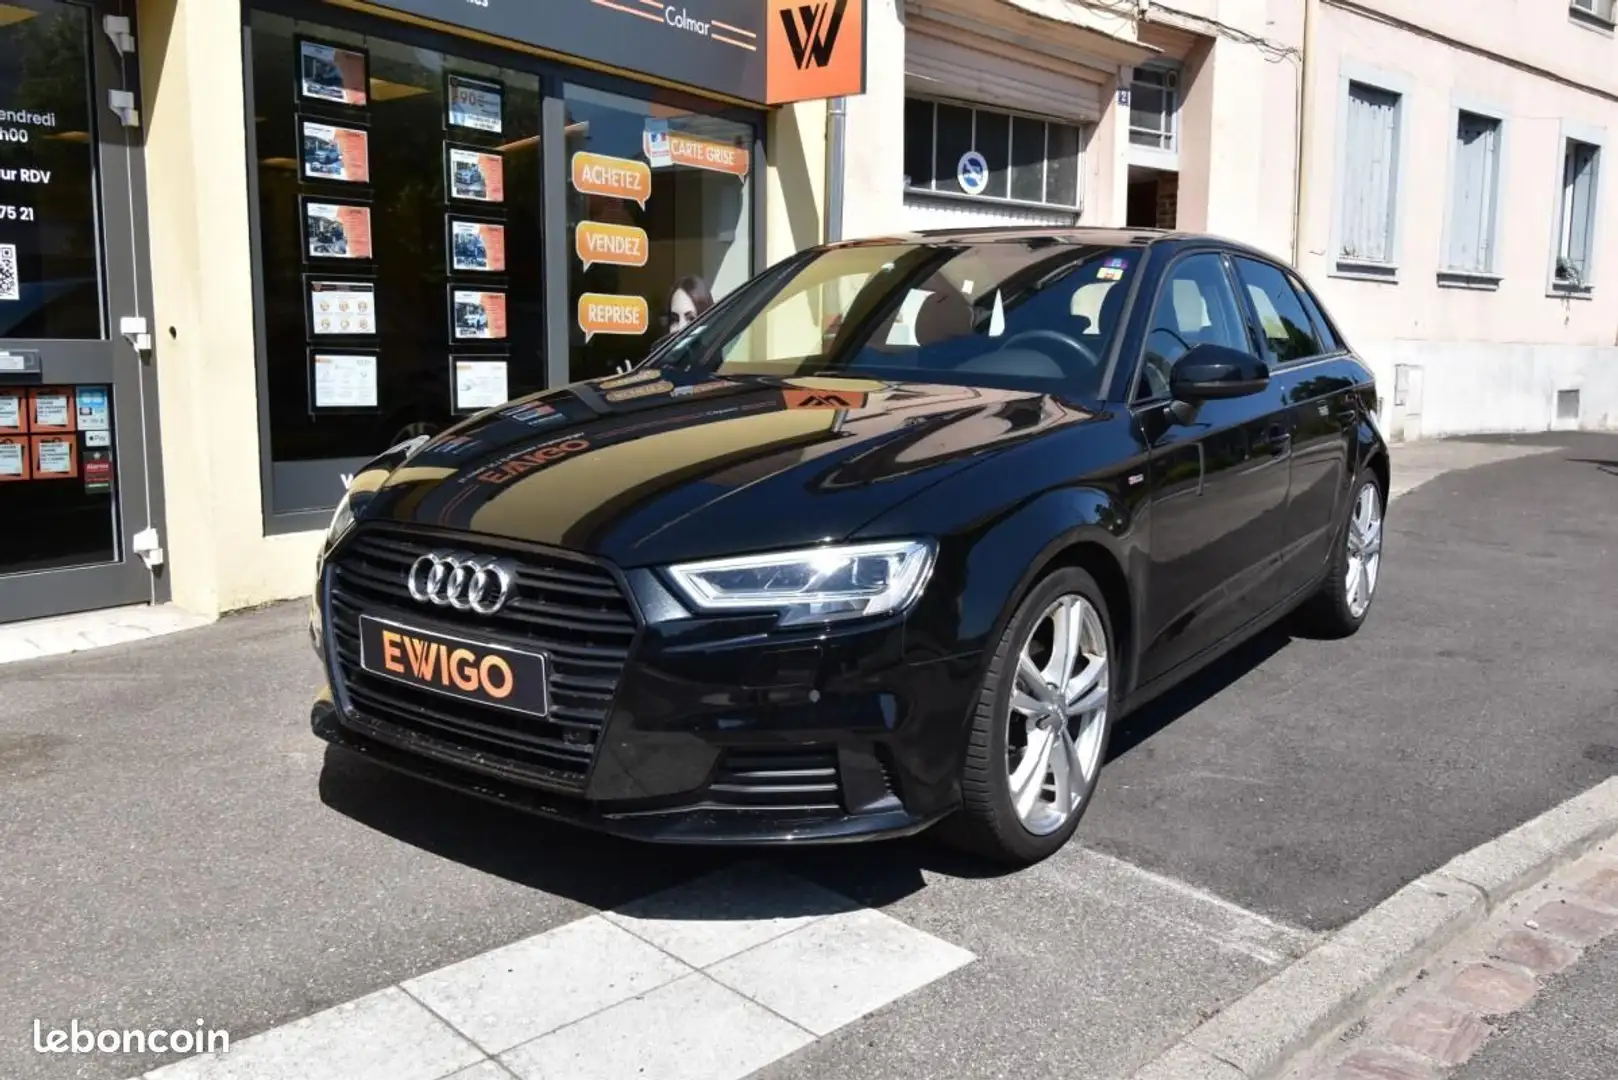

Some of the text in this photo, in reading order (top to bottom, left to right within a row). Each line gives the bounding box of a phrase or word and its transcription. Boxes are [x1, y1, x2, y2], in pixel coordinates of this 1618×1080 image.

[665, 6, 711, 36] Colmar
[0, 109, 56, 127] endredi
[0, 127, 28, 143] h00
[671, 139, 736, 165] CARTE GRISE
[0, 168, 51, 184] ur RDV
[582, 163, 643, 190] ACHETEZ
[0, 204, 34, 221] 75 21
[586, 231, 641, 256] VENDEZ
[588, 303, 640, 325] REPRISE
[382, 629, 513, 698] EWIGO
